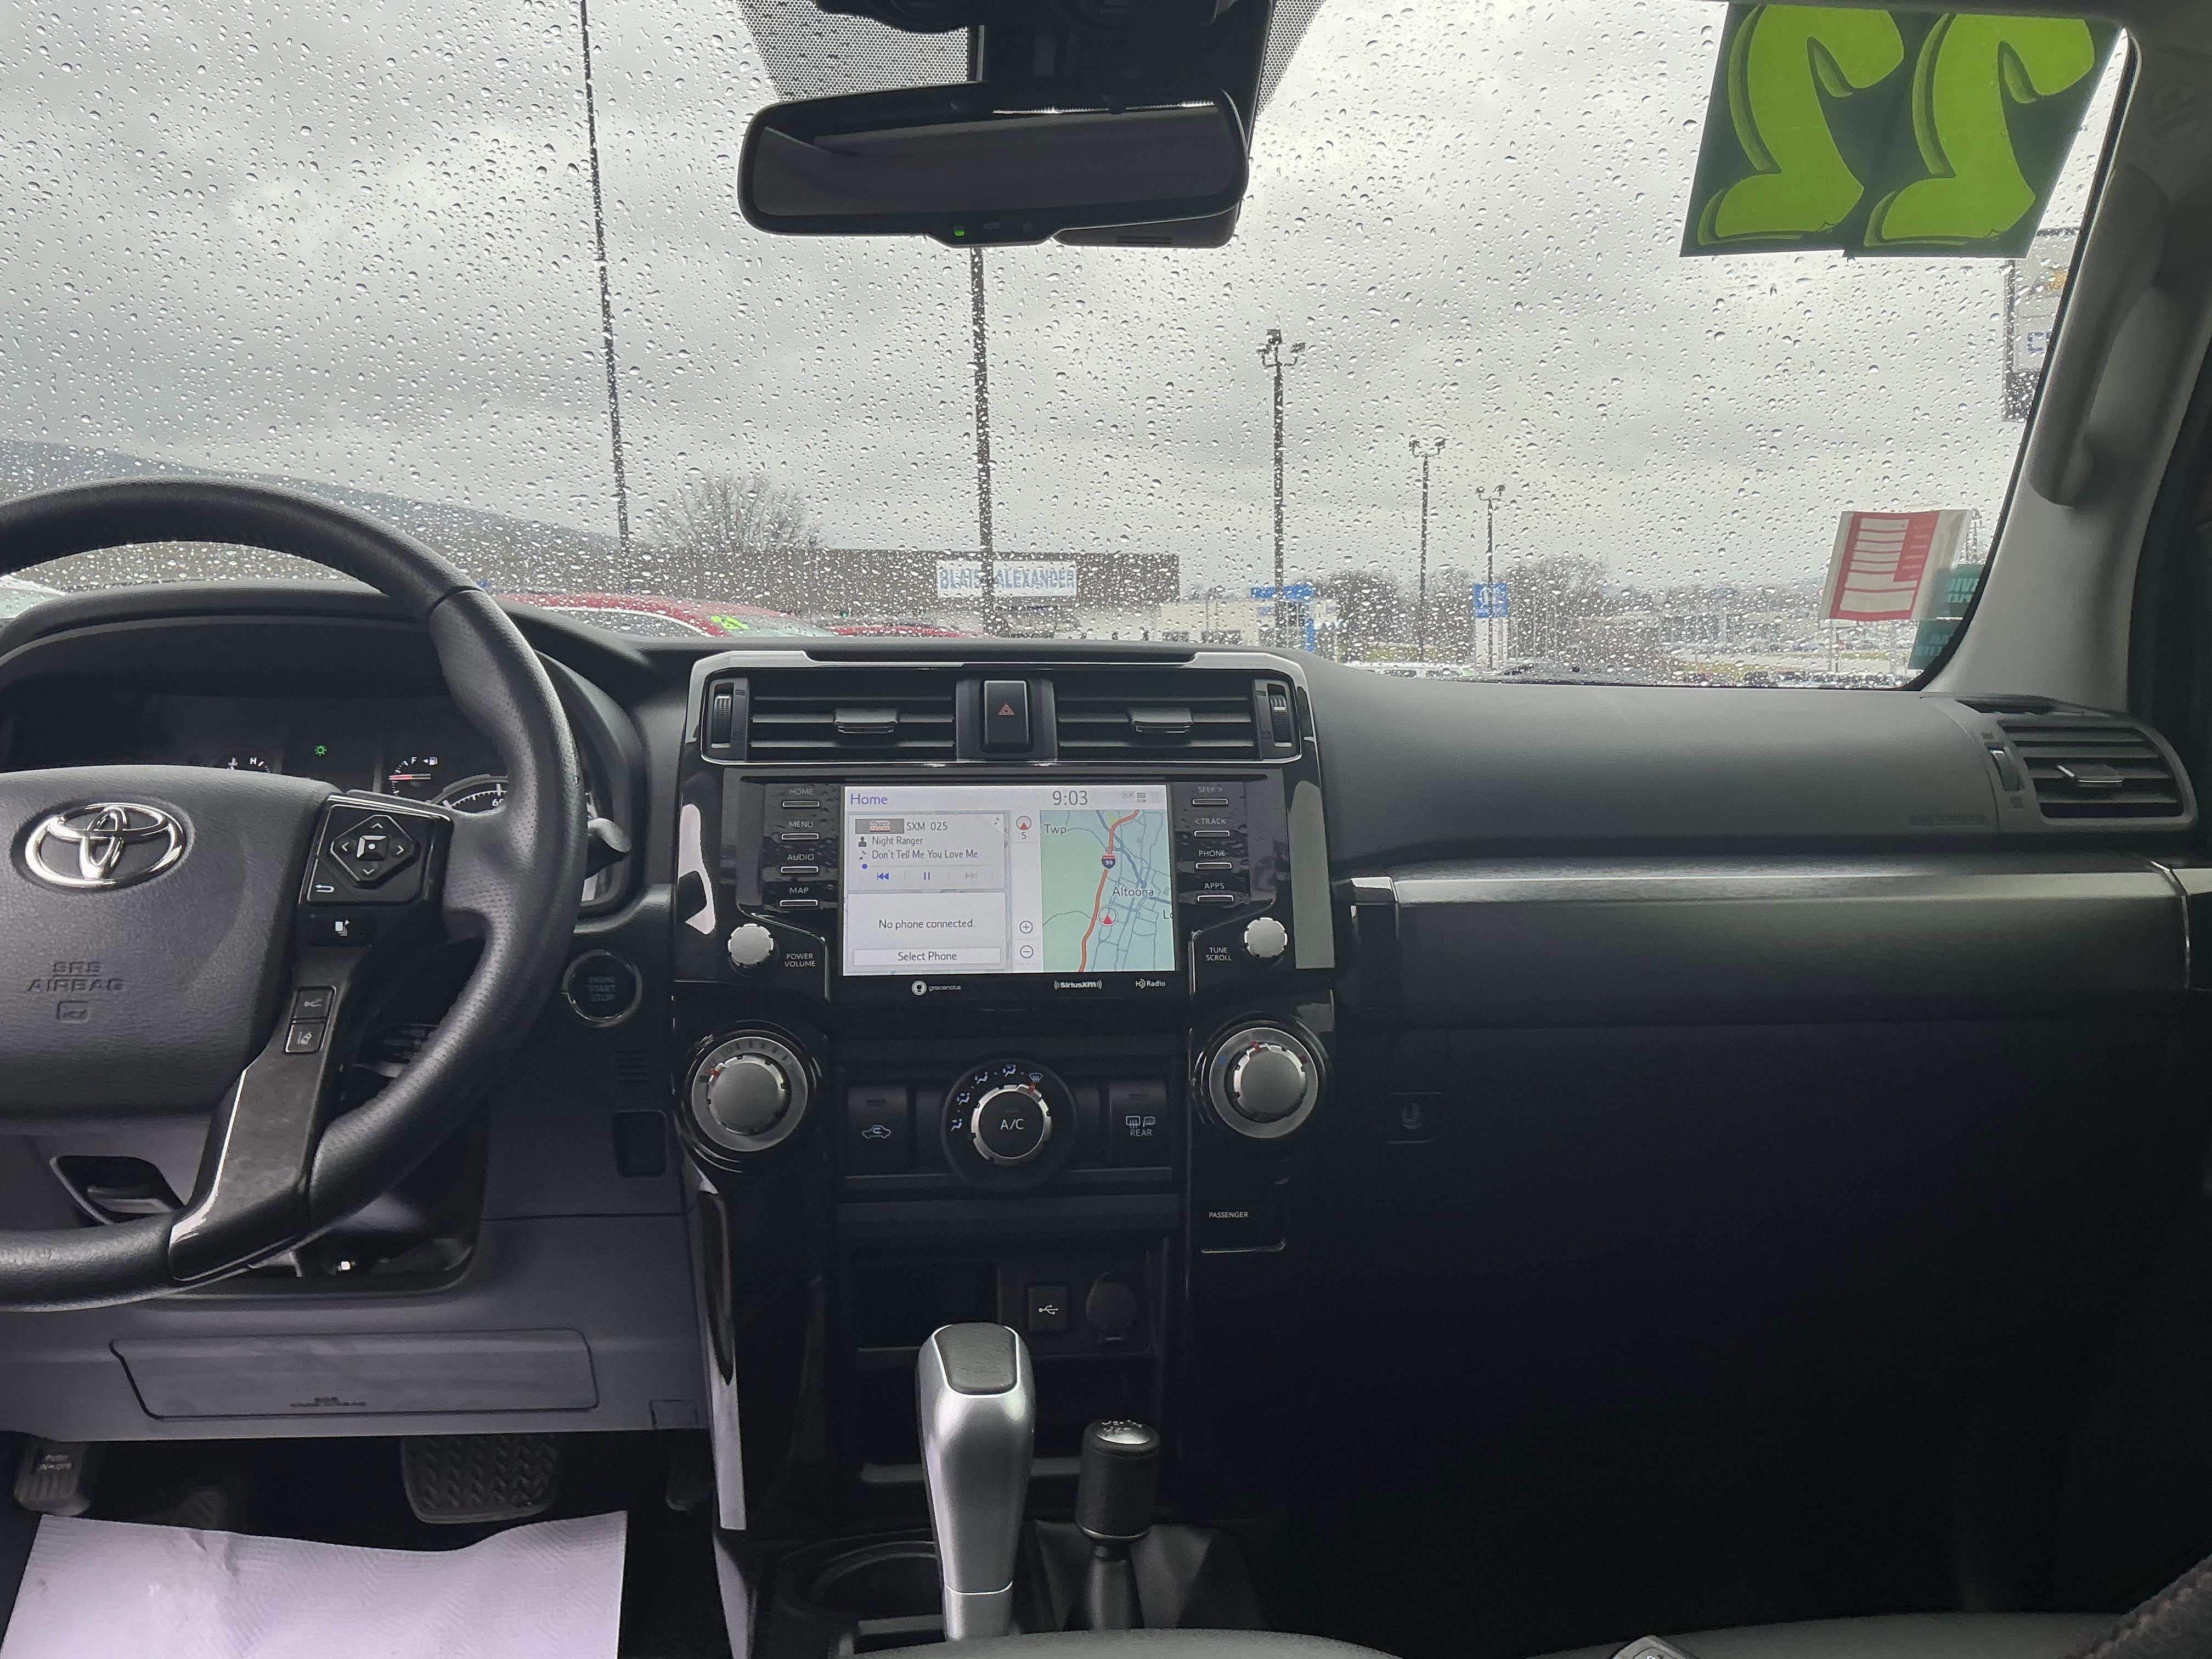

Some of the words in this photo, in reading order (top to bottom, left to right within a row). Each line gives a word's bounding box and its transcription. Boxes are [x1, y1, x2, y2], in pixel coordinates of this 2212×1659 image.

[939, 568, 983, 589] BLAIS
[994, 569, 1075, 589] ALEXANDER
[250, 757, 258, 765] H
[850, 793, 888, 805] Home
[1052, 790, 1088, 806] 9:03
[906, 822, 926, 832] SXM
[930, 822, 948, 831] 025
[1044, 823, 1067, 836] Twp
[1021, 831, 1028, 840] S
[872, 836, 894, 847] Night
[896, 837, 923, 847] Ranger
[871, 850, 894, 860] Don't
[895, 850, 910, 859] Tell
[912, 850, 925, 859] Me
[927, 850, 943, 859] You
[944, 850, 964, 859] Love
[966, 849, 978, 859] Me
[1111, 886, 1154, 897] Altoona
[878, 919, 893, 929] No
[895, 919, 924, 930] phone
[926, 918, 976, 929] connected.
[897, 951, 927, 962] Select
[928, 951, 957, 961] Phone
[27, 978, 125, 992] AIRBAG
[1000, 1117, 1024, 1132] A/C
[1130, 1128, 1153, 1137] REAR
[1209, 1211, 1249, 1219] PASSENGER
